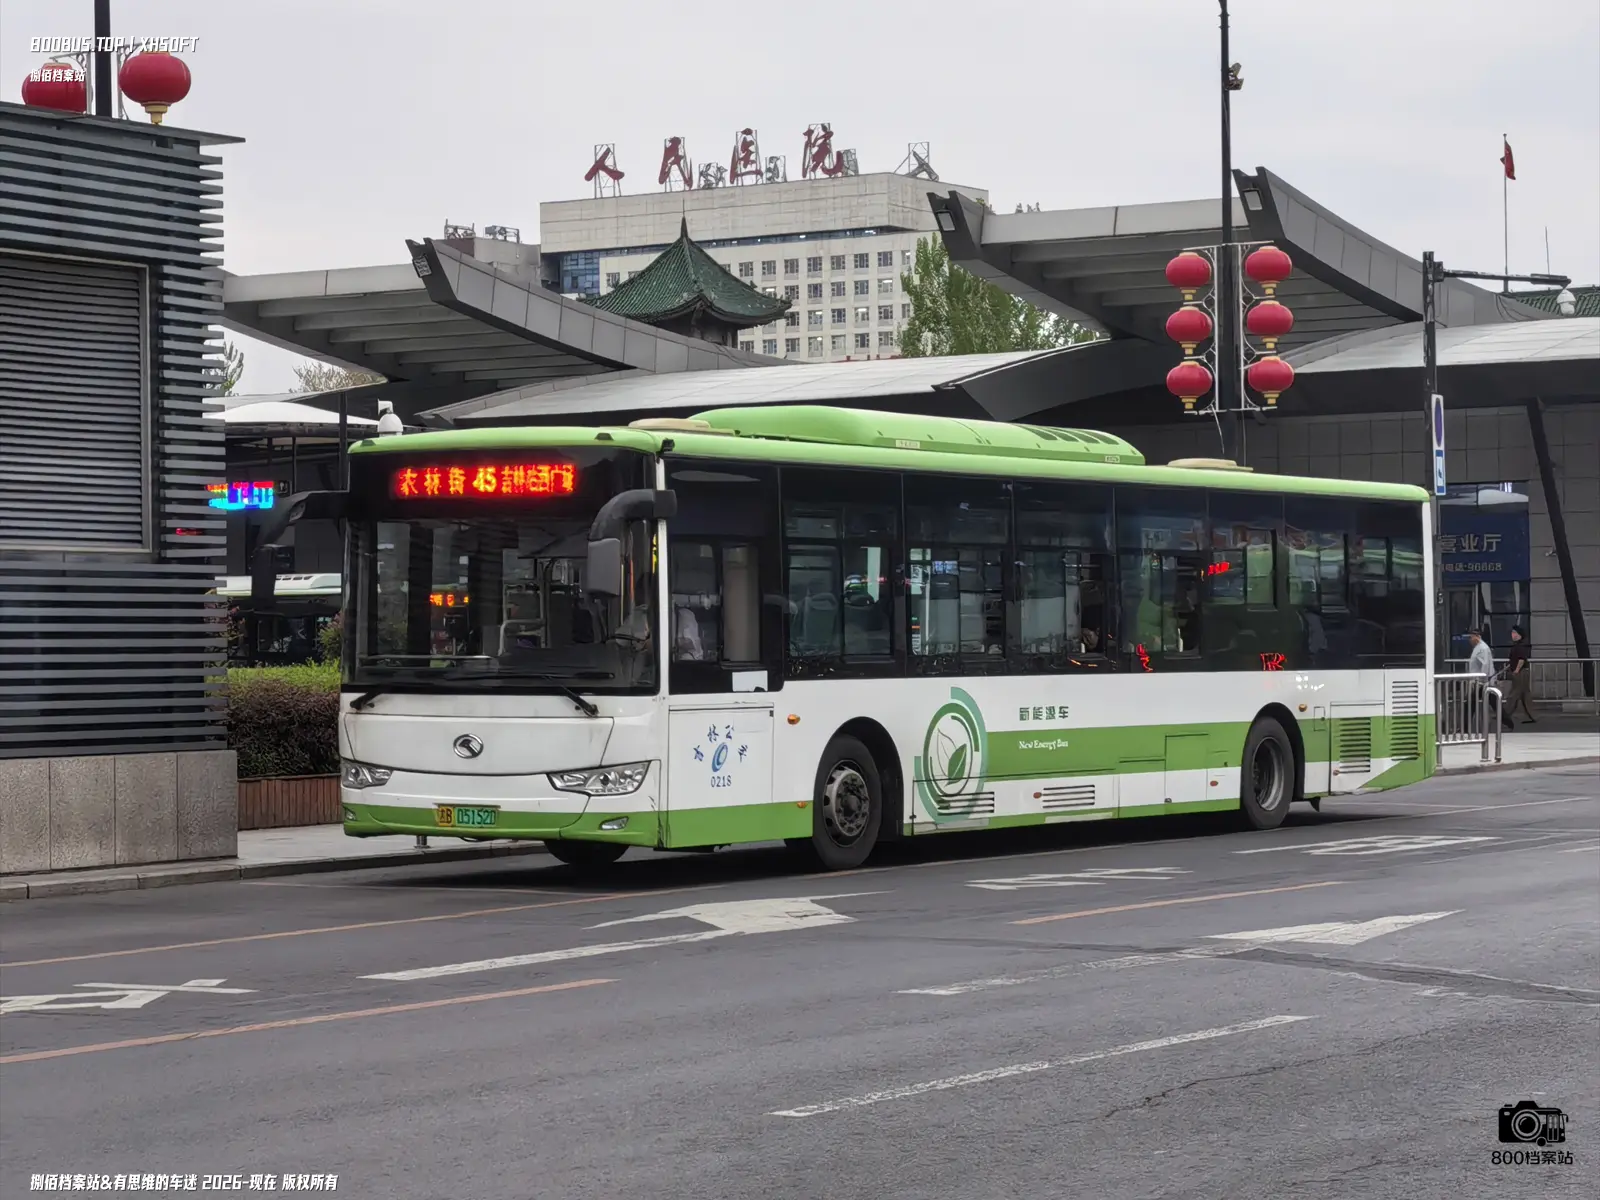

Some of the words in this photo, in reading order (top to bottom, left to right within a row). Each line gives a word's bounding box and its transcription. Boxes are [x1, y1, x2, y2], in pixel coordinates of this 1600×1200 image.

[584, 123, 844, 190] 人民医院
[472, 466, 497, 493] 45
[1439, 533, 1502, 553] 营业厅
